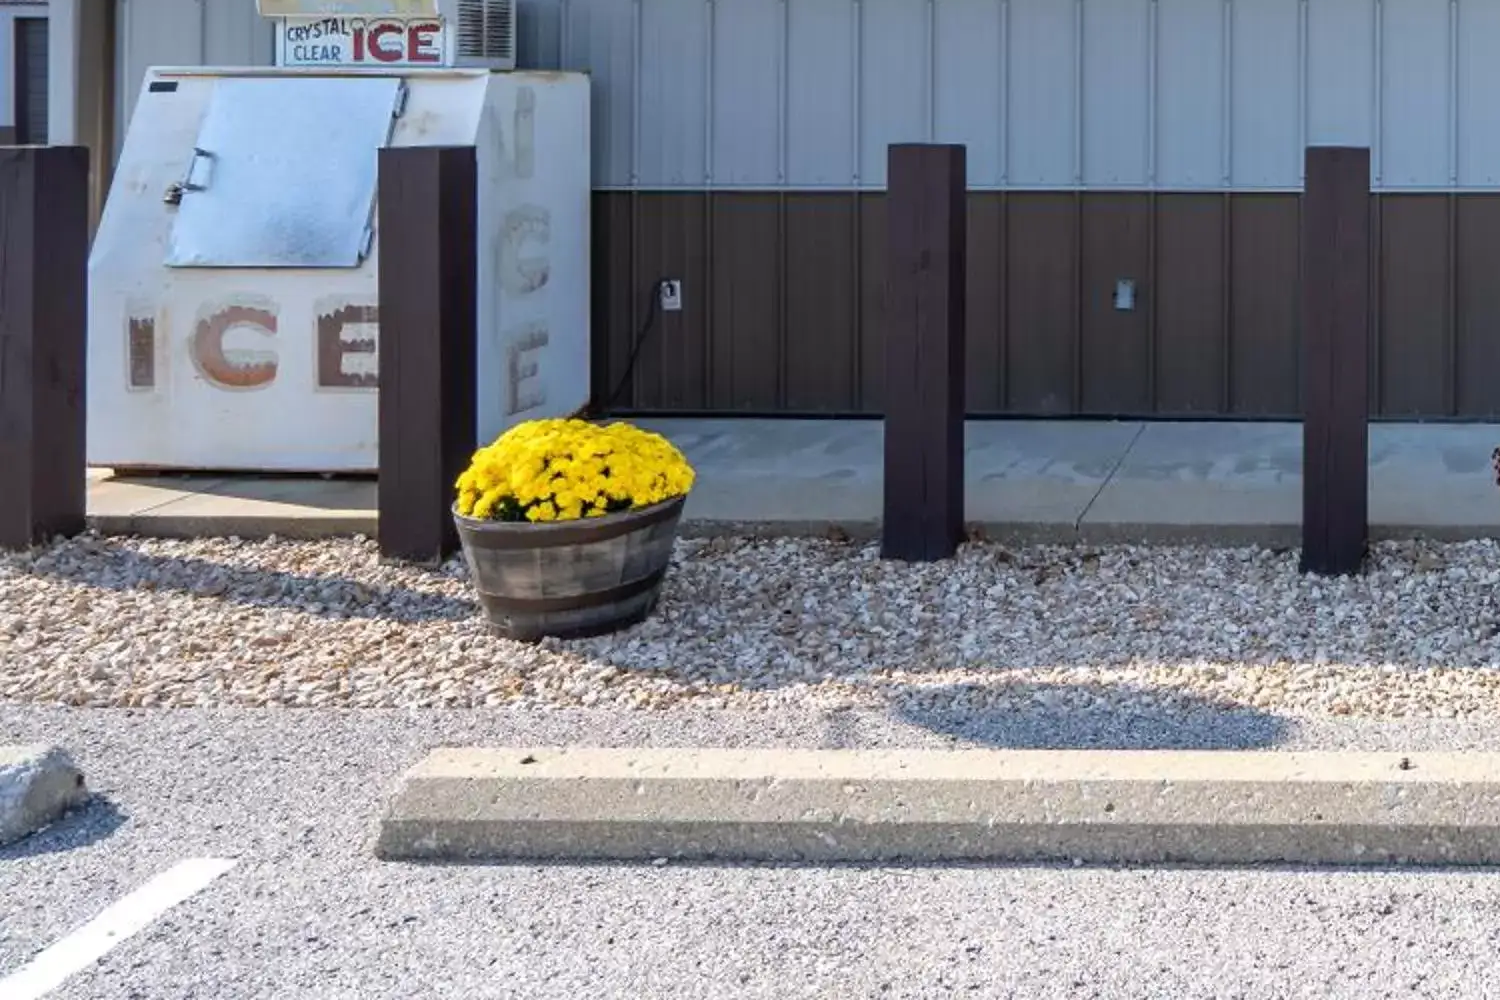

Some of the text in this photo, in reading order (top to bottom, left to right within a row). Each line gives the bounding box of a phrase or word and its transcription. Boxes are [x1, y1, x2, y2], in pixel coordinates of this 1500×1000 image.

[287, 16, 350, 43] CRYSTAL
[351, 19, 442, 63] ICE
[294, 44, 341, 62] CLEAR
[128, 296, 379, 391] ICE
